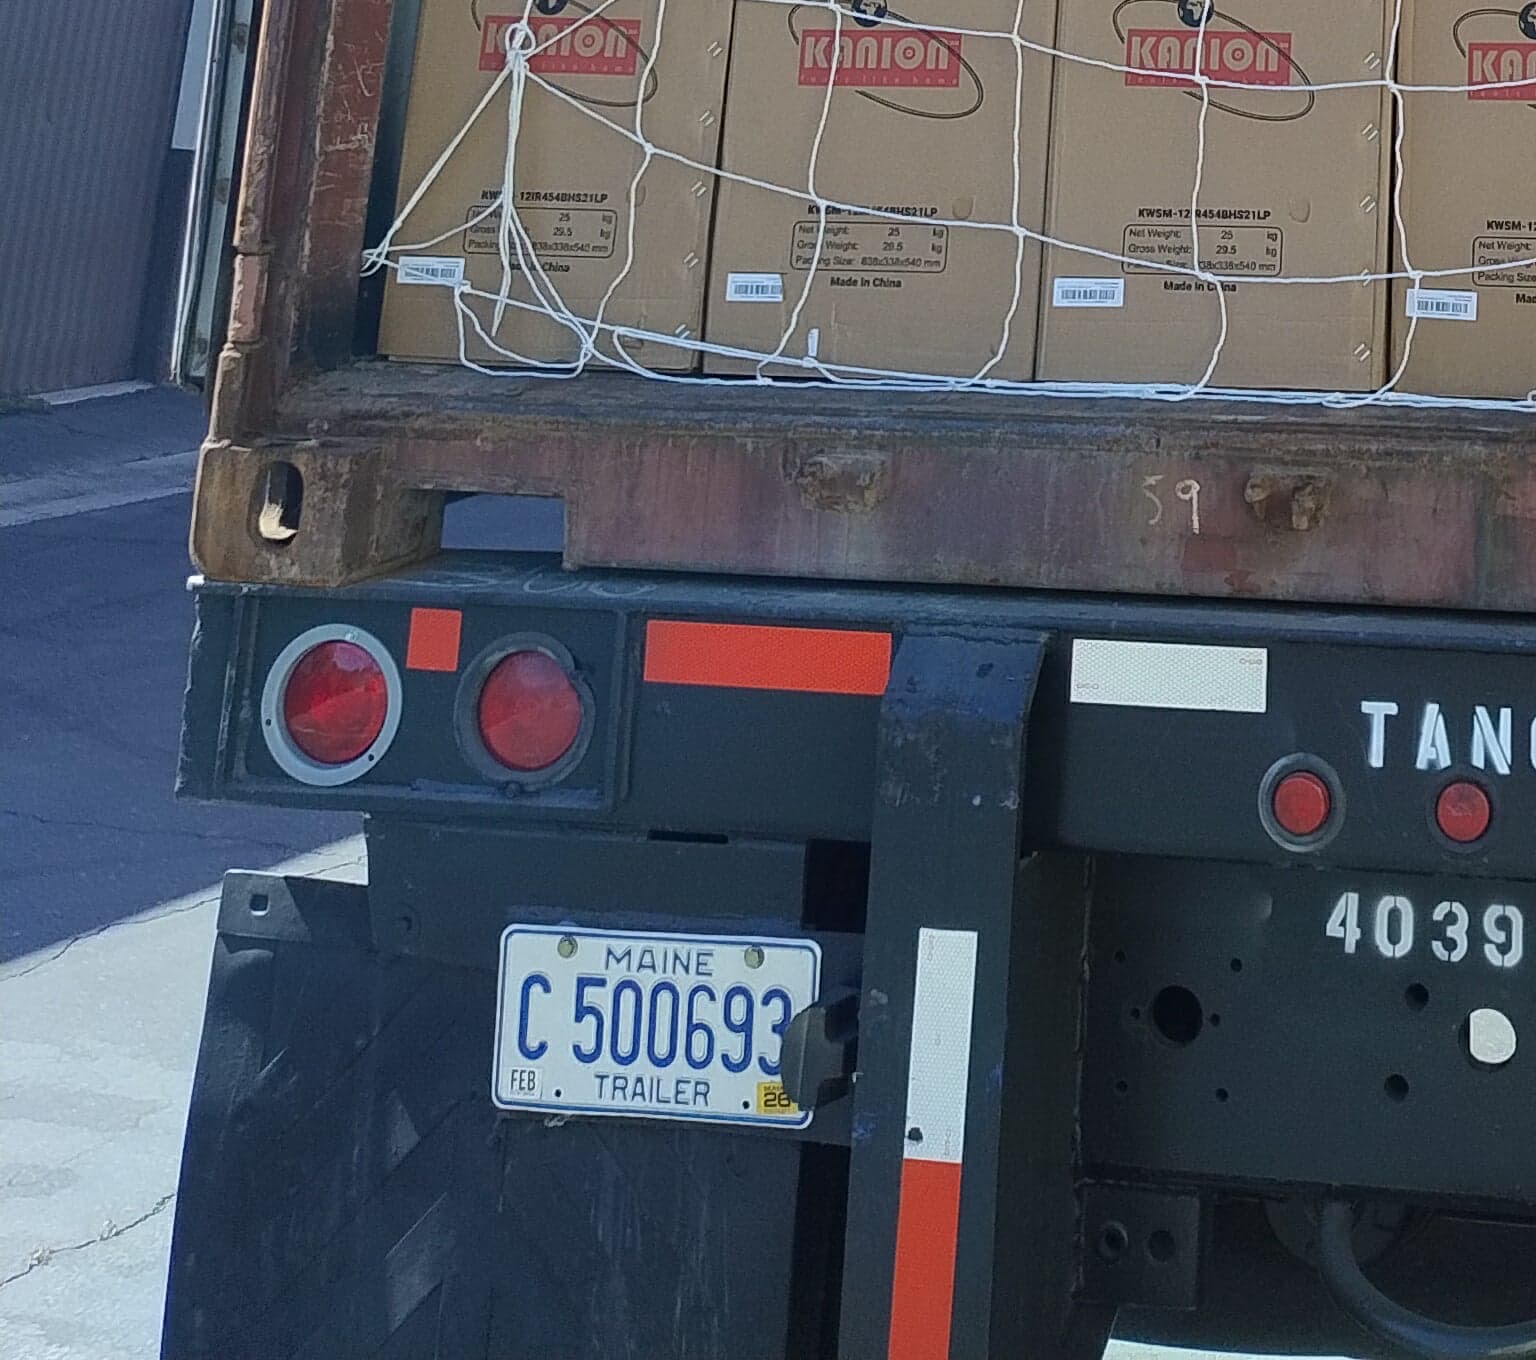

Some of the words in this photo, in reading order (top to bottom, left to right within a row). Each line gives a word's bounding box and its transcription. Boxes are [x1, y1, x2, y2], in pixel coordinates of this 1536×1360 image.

[804, 36, 947, 71] KANION
[830, 276, 858, 287] Made
[872, 278, 902, 288] China
[1163, 281, 1192, 291] Made
[604, 946, 714, 976] MAINE
[517, 973, 552, 1060] C
[572, 975, 793, 1076] 500693
[510, 1068, 536, 1091] FEB
[594, 1073, 711, 1106] TRAILER
